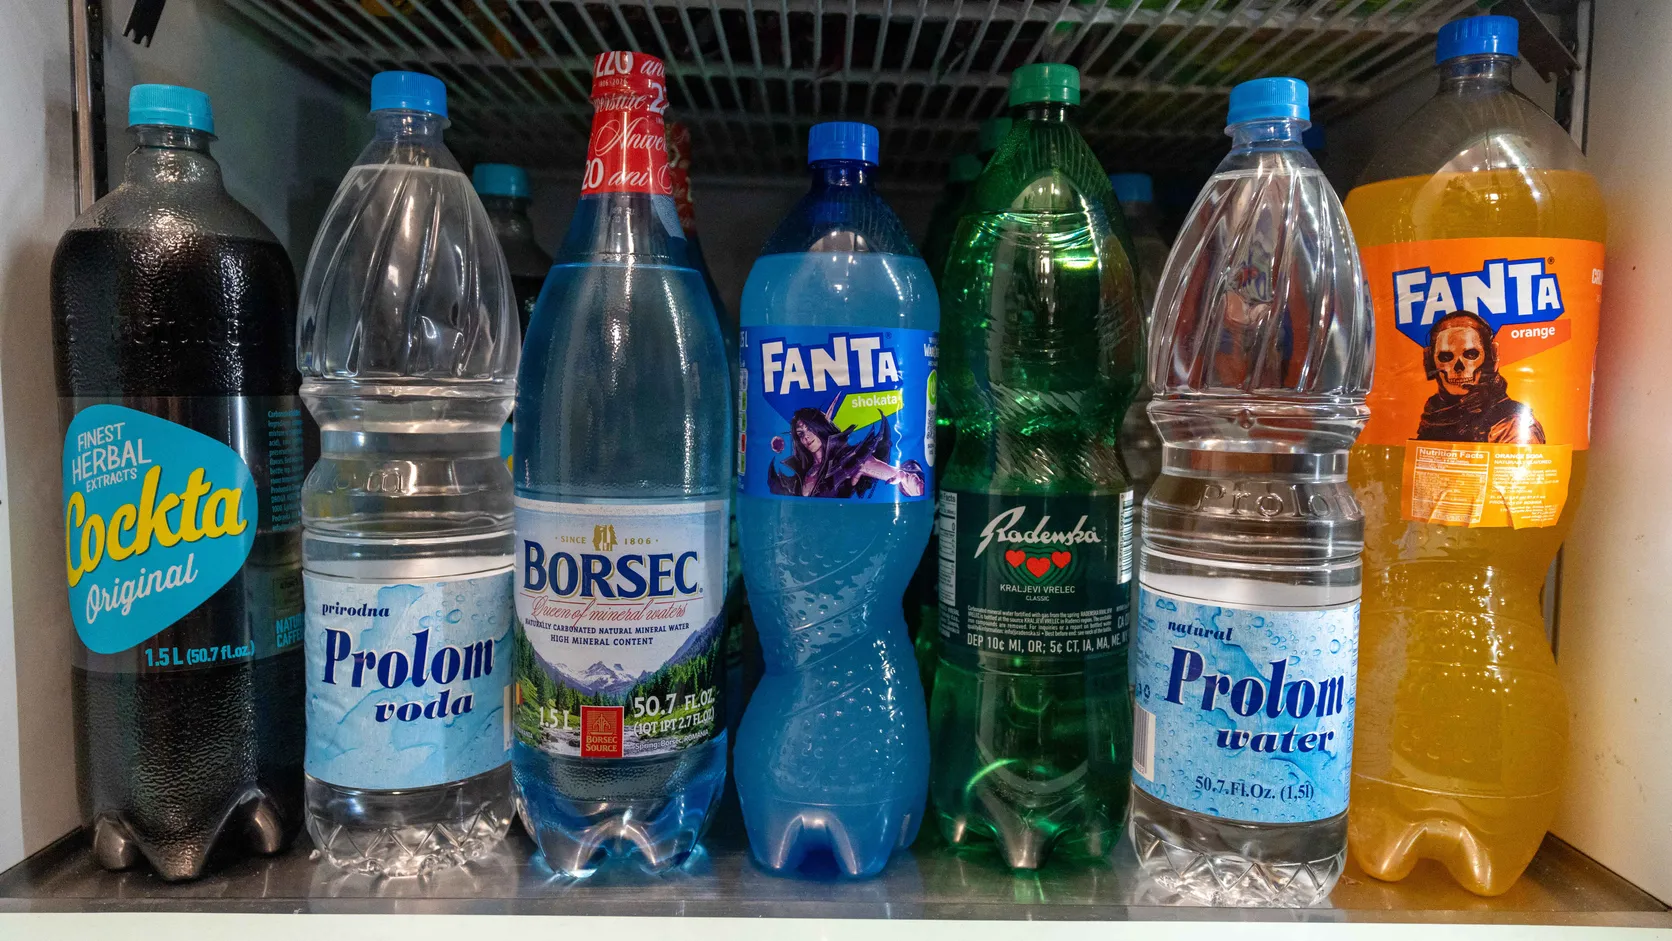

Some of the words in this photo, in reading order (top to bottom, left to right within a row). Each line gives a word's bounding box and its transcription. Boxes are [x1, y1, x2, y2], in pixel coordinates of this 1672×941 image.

[608, 167, 650, 187] ani
[1395, 262, 1561, 327] FANTA
[1511, 326, 1556, 340] orange
[762, 336, 899, 395] FANTA
[851, 394, 899, 409] shokata
[77, 422, 126, 453] FINEST
[72, 438, 153, 485] HERBAL
[1419, 448, 1457, 458] Nutrition
[86, 467, 138, 493] EXTRACTS
[65, 465, 248, 587] Cockta
[974, 506, 1102, 559] Radenska
[561, 535, 587, 545] SINCE
[624, 537, 651, 546] 1806
[523, 539, 699, 599] BORSEC
[85, 552, 199, 625] Original
[1000, 583, 1042, 594] KRALJEVI
[1043, 585, 1076, 594] VRELEC
[321, 602, 390, 618] prirodna
[531, 594, 571, 621] Queen
[571, 599, 596, 628] of
[588, 599, 654, 621] mineral
[646, 602, 688, 620] waters
[525, 617, 552, 631] NATURALLY
[553, 623, 597, 635] CARBONATED
[598, 627, 633, 635] NATURAL
[634, 625, 668, 634] MINERAL
[668, 622, 690, 632] WATER
[1168, 620, 1234, 642] natural
[550, 634, 570, 644] HIGH
[571, 636, 610, 646] MINERAL
[613, 637, 654, 646] CONTENT
[967, 632, 984, 647] DEP
[987, 636, 1005, 651] 10¢
[1009, 638, 1024, 653] MI,
[1028, 640, 1046, 654] OR;
[1050, 640, 1062, 653] 5¢
[1067, 639, 1080, 653] CT,
[1083, 638, 1095, 652] IA,
[1096, 636, 1110, 650] MA,
[145, 647, 170, 667] 1.5
[172, 647, 184, 666] L
[186, 646, 219, 665] (50.7
[220, 640, 255, 661] fl.oz.)
[321, 628, 496, 690] Prolom
[1164, 646, 1346, 719] Prolom
[374, 689, 474, 723] voda
[633, 692, 677, 718] 50.7
[684, 687, 715, 711] FL.OZ.
[539, 706, 559, 731] 1.5
[562, 709, 573, 731] L
[633, 721, 659, 739] (1QT
[660, 718, 677, 733] 1PT
[678, 714, 692, 730] 2.7
[585, 735, 618, 744] BORSEC
[585, 744, 618, 752] SOURCE
[1216, 724, 1336, 753] water
